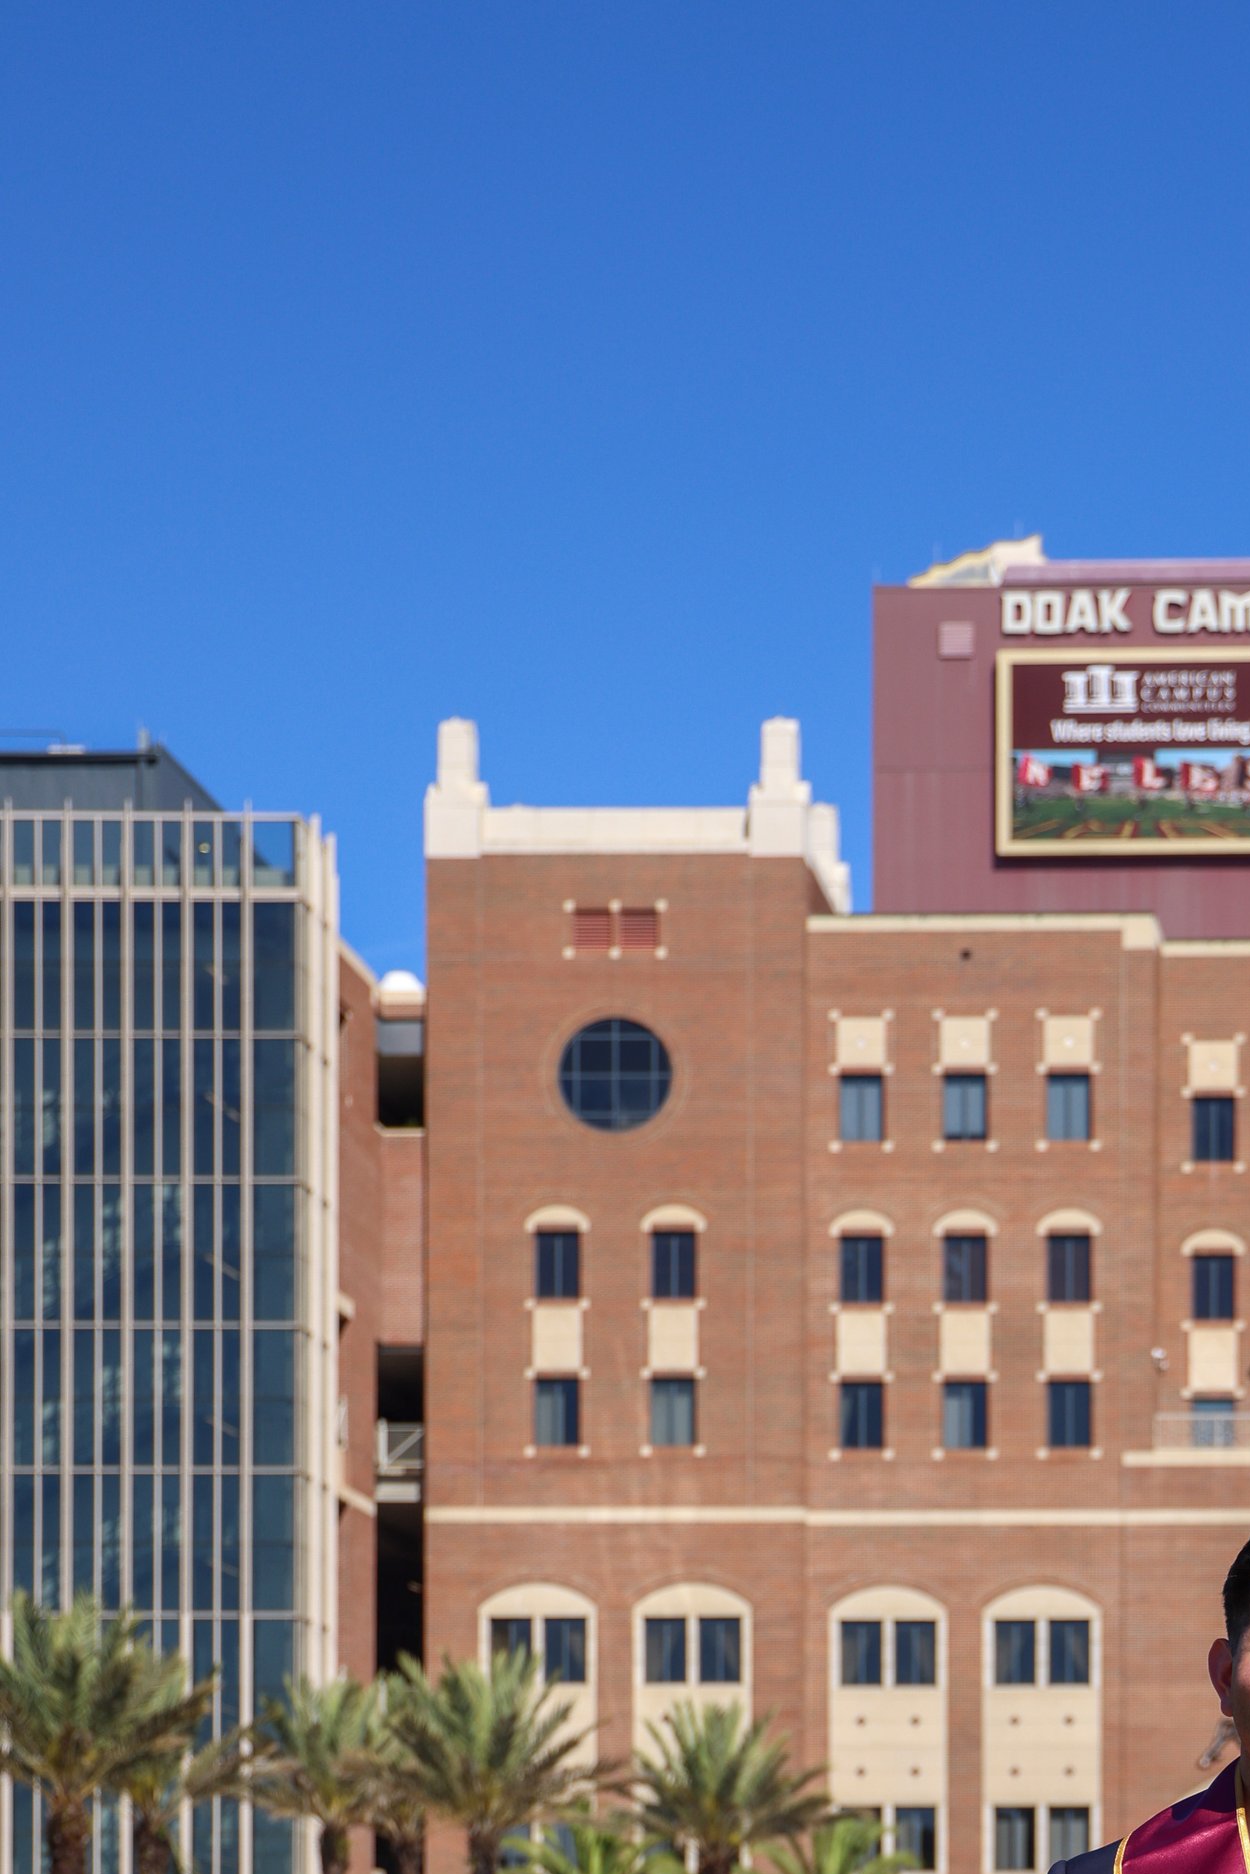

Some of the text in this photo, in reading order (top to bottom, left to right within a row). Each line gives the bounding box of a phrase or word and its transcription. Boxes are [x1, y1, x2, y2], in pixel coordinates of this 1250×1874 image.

[1001, 588, 1132, 636] DOAK
[1142, 670, 1236, 687] AMERICAN
[1141, 686, 1236, 702] CAMPUS
[1050, 718, 1103, 743] Where
[1105, 718, 1172, 743] students
[1172, 718, 1207, 743] love
